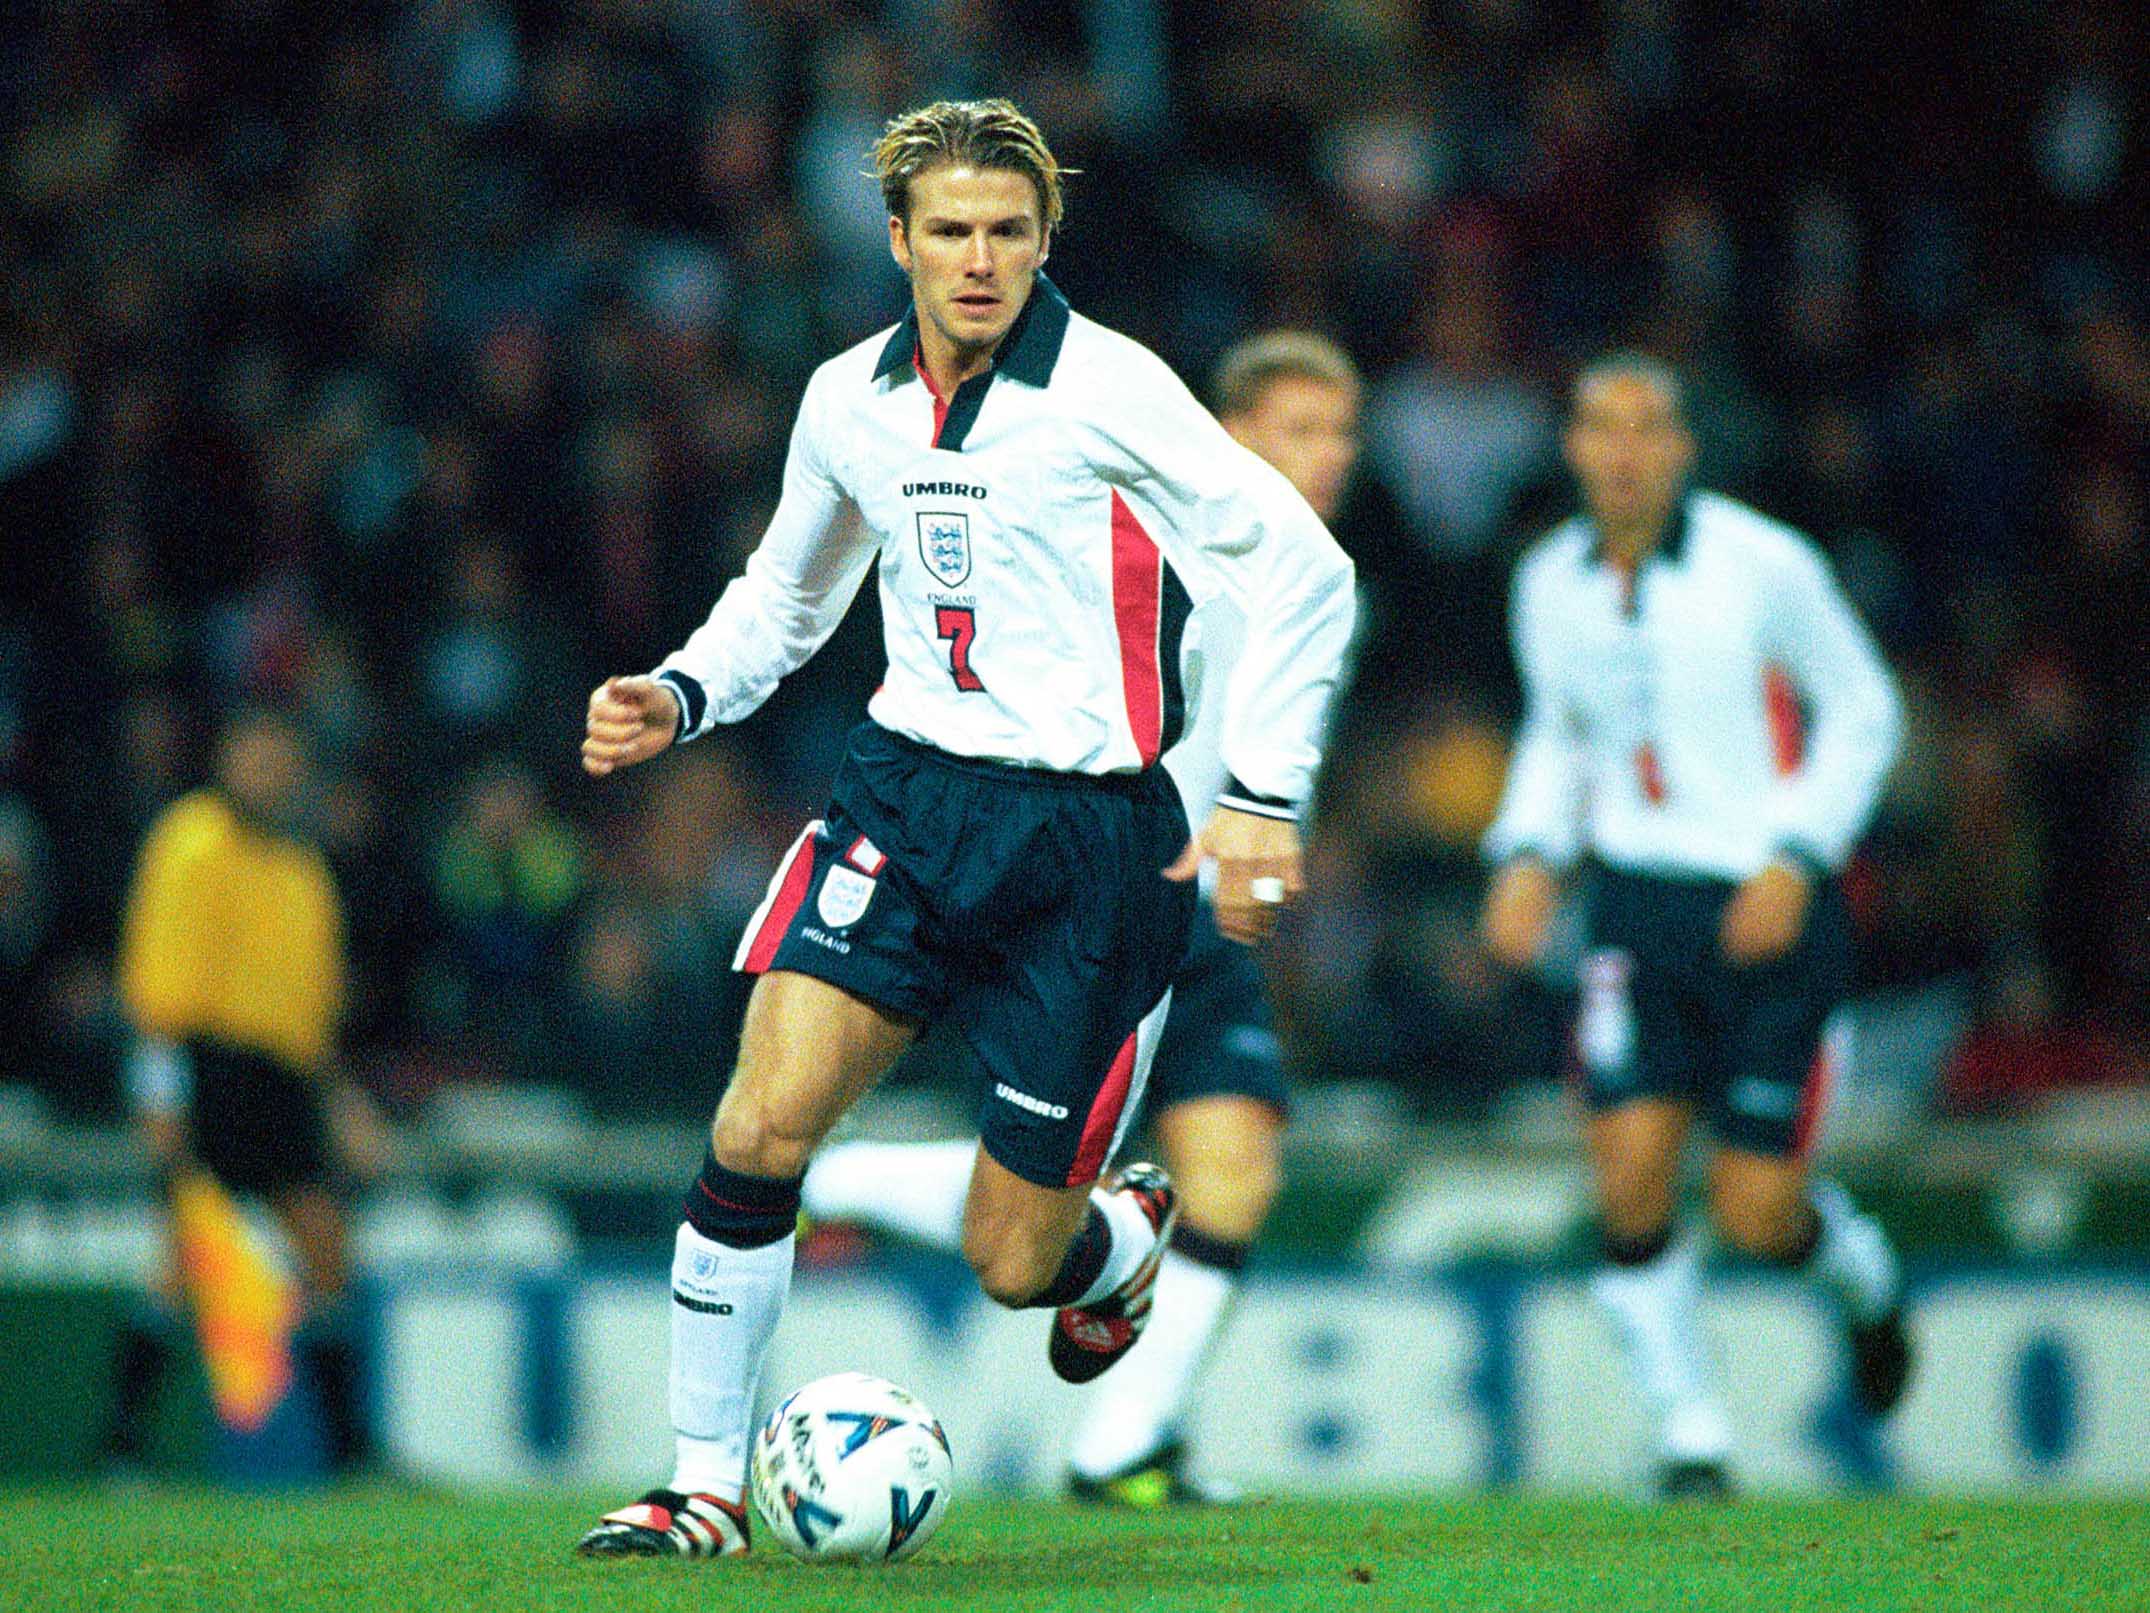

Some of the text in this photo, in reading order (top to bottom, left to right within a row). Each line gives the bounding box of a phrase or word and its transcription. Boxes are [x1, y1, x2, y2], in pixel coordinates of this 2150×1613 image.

[902, 482, 987, 499] UMBRO
[934, 604, 987, 693] 7
[801, 926, 850, 955] NGLAND
[996, 1082, 1068, 1119] UMBRO
